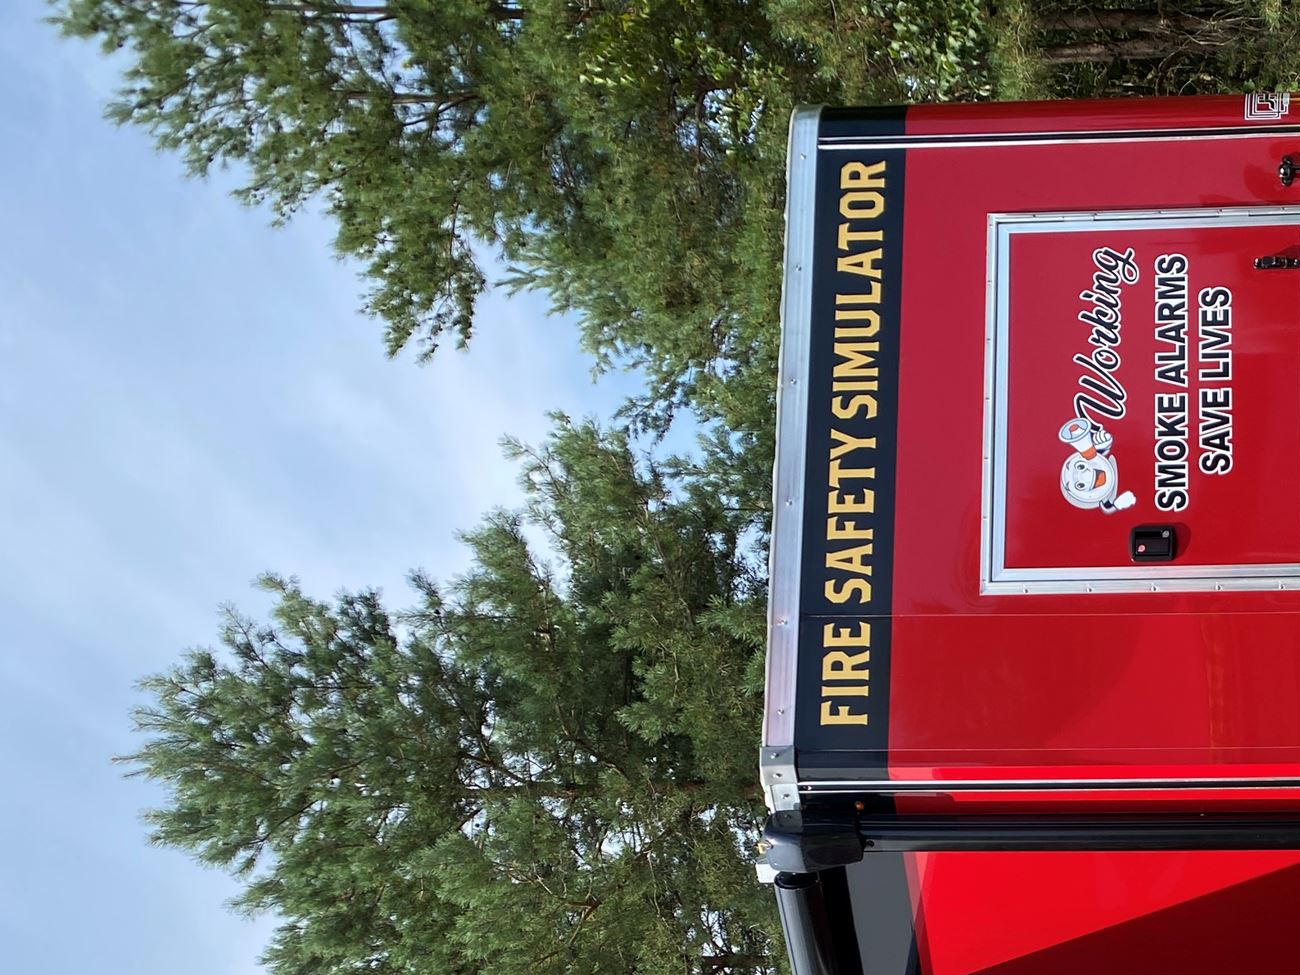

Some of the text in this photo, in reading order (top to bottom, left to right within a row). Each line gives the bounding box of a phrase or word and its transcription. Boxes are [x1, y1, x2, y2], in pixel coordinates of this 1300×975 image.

[820, 160, 886, 727] FIRE SAFETY SIMULATOR
[1072, 246, 1140, 431] Working
[1154, 253, 1188, 511] SMOKE ALARMS
[1197, 287, 1233, 474] SAVE LIVES
